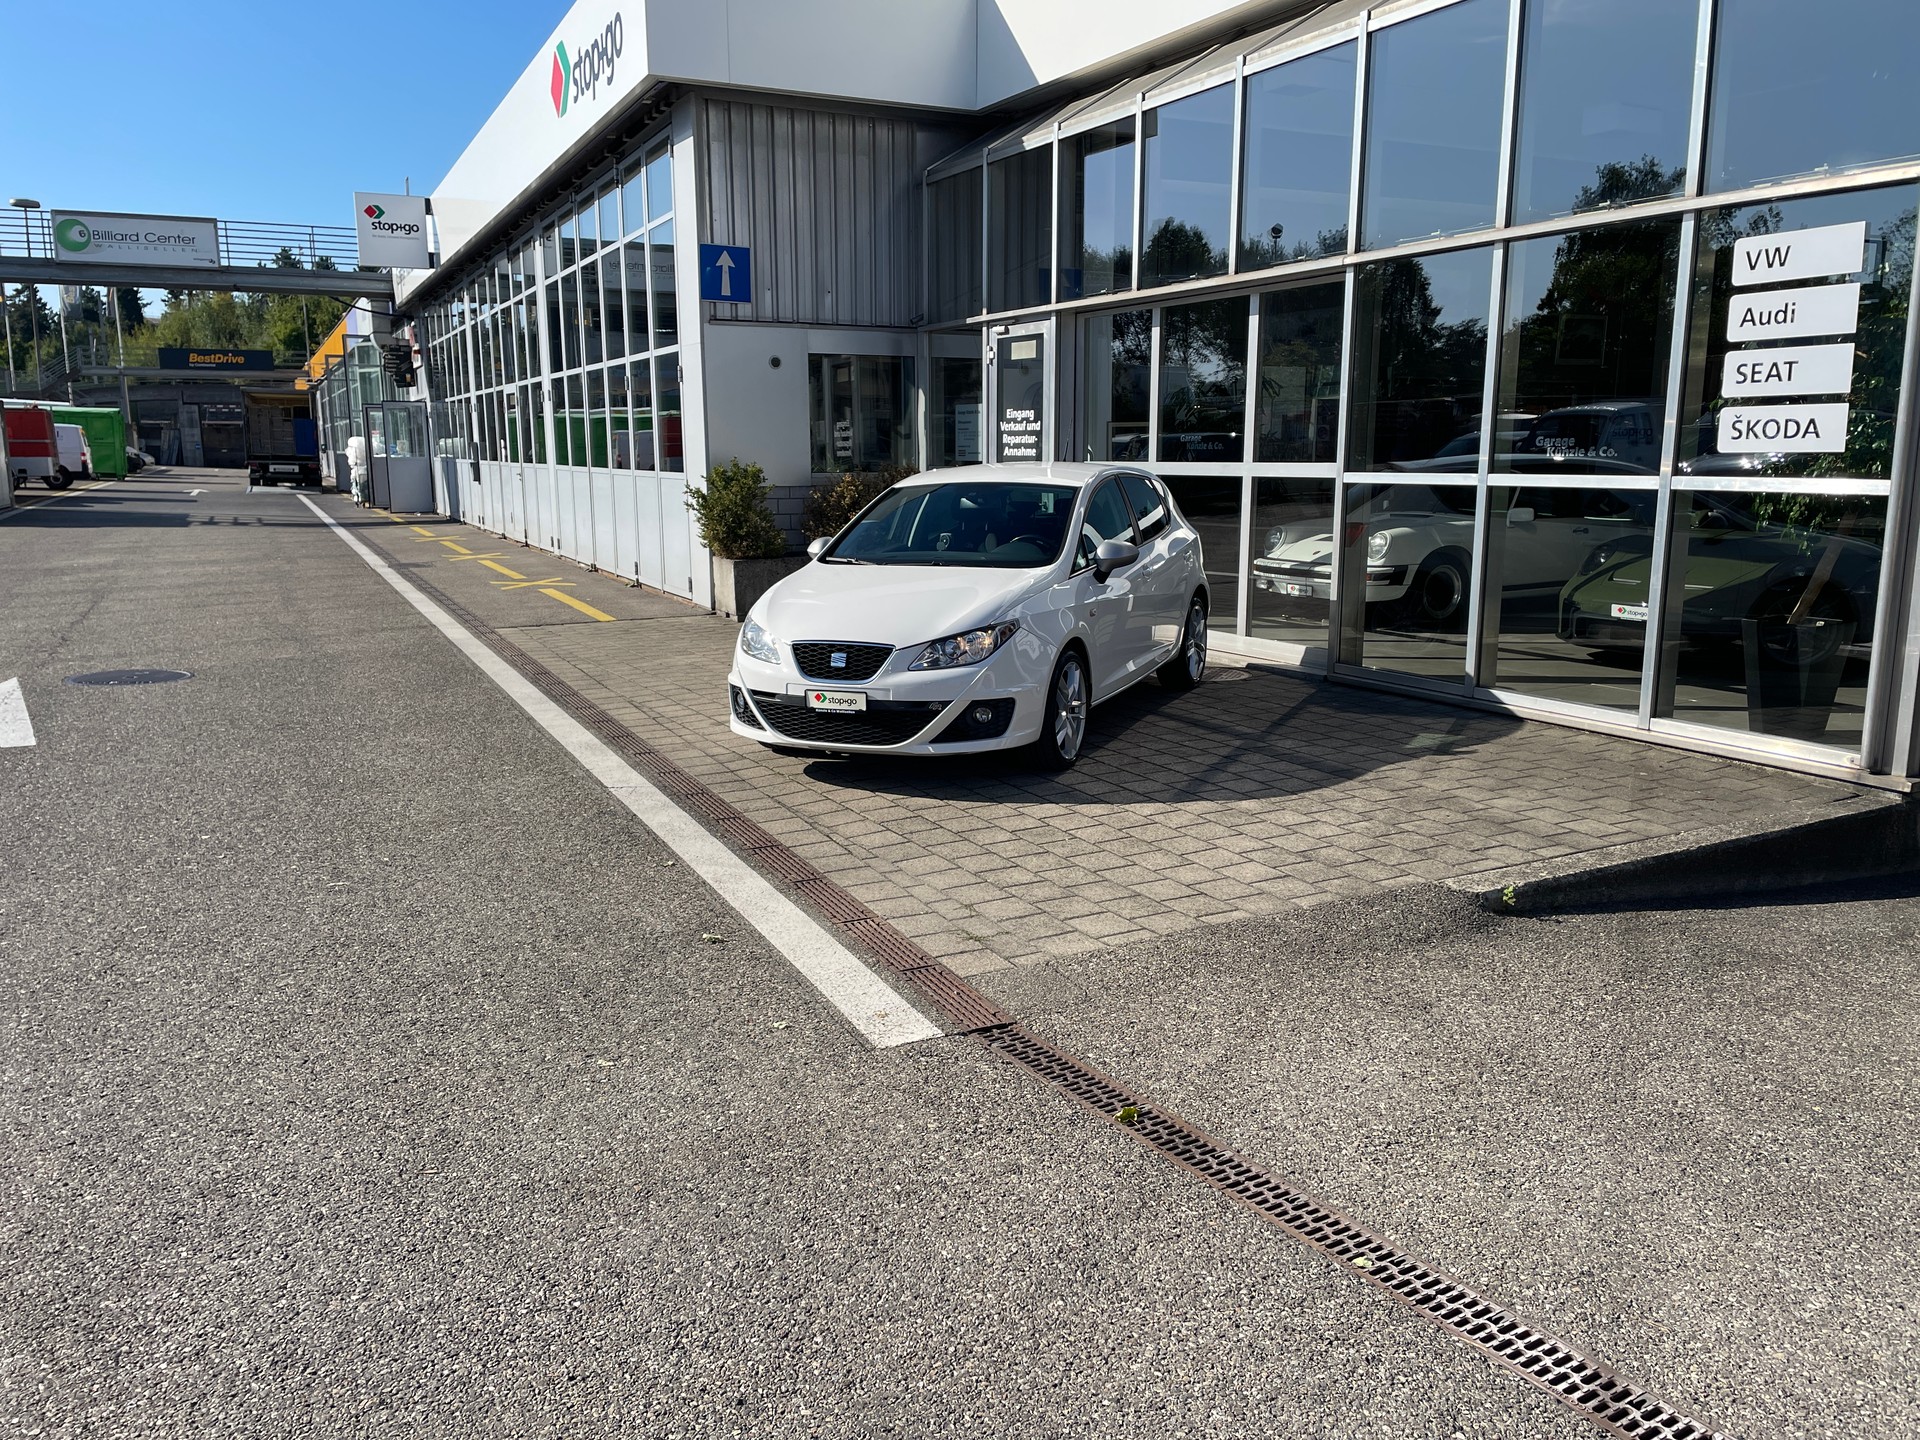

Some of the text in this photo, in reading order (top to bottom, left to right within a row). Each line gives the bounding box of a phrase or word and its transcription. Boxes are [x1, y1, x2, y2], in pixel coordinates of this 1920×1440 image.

[572, 11, 623, 104] stop+go
[371, 220, 420, 235] stop+go
[92, 229, 196, 245] Billiard Center
[93, 243, 198, 253] WALLISELLEN
[1746, 245, 1791, 271] VW
[1739, 302, 1796, 328] Audi
[188, 353, 245, 364] BestDrive
[1735, 360, 1799, 384] SEAT
[1006, 408, 1034, 420] Eingang
[1000, 420, 1041, 431] Verkauf und
[1730, 414, 1820, 440] ŠKODA
[1002, 434, 1038, 446] Reparatur-
[1180, 434, 1202, 443] Garage
[1535, 436, 1575, 449] Garage
[1003, 446, 1036, 456] Annahme
[1546, 446, 1618, 457] Künzle & Co.
[828, 696, 857, 706] stop+go
